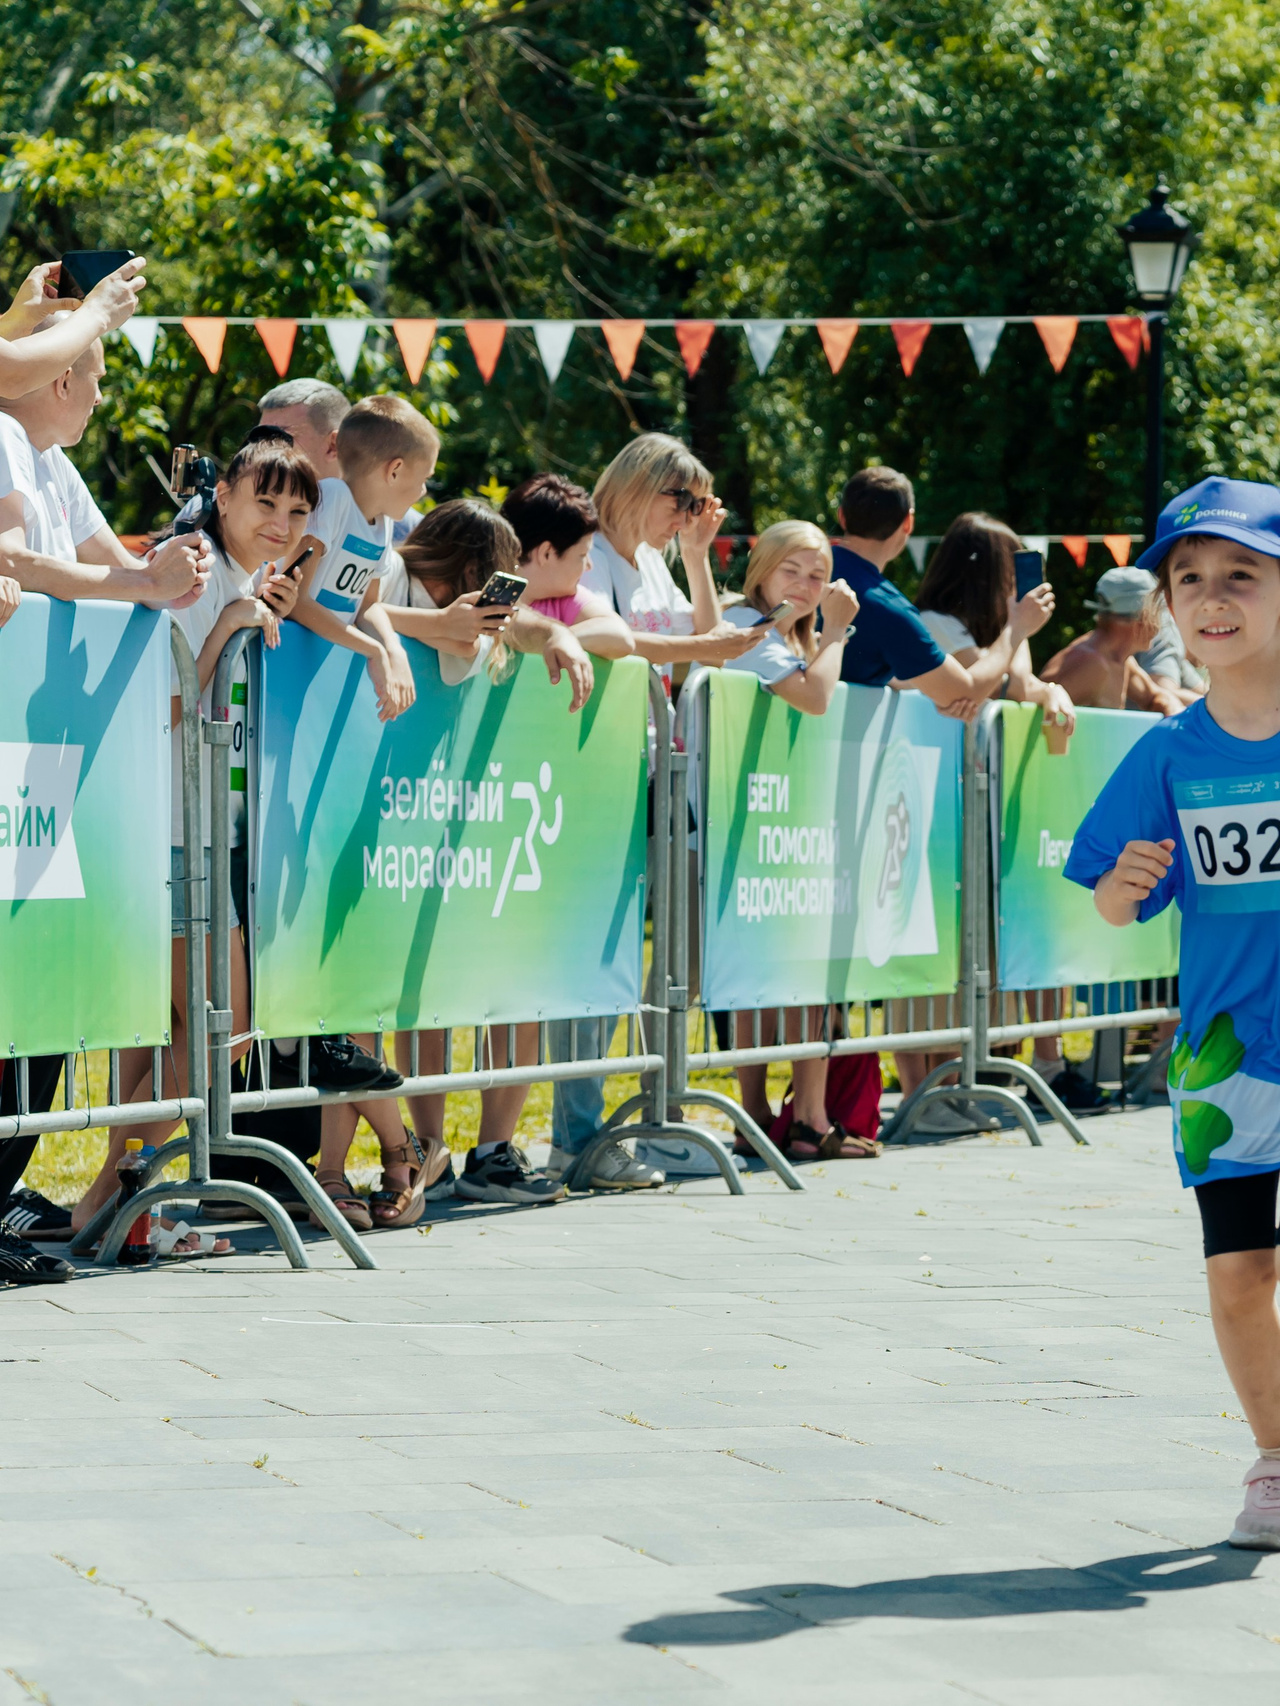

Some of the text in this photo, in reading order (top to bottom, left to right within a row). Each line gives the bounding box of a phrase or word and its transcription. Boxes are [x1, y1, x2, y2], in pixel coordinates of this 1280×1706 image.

[1195, 508, 1248, 521] росинка
[380, 759, 504, 822] зелёный
[747, 773, 789, 813] БЕГИ
[363, 827, 492, 903] марафон
[758, 819, 840, 865] ПОМОГАЙ
[737, 870, 852, 923] ВДОХНОВЛЯЙ
